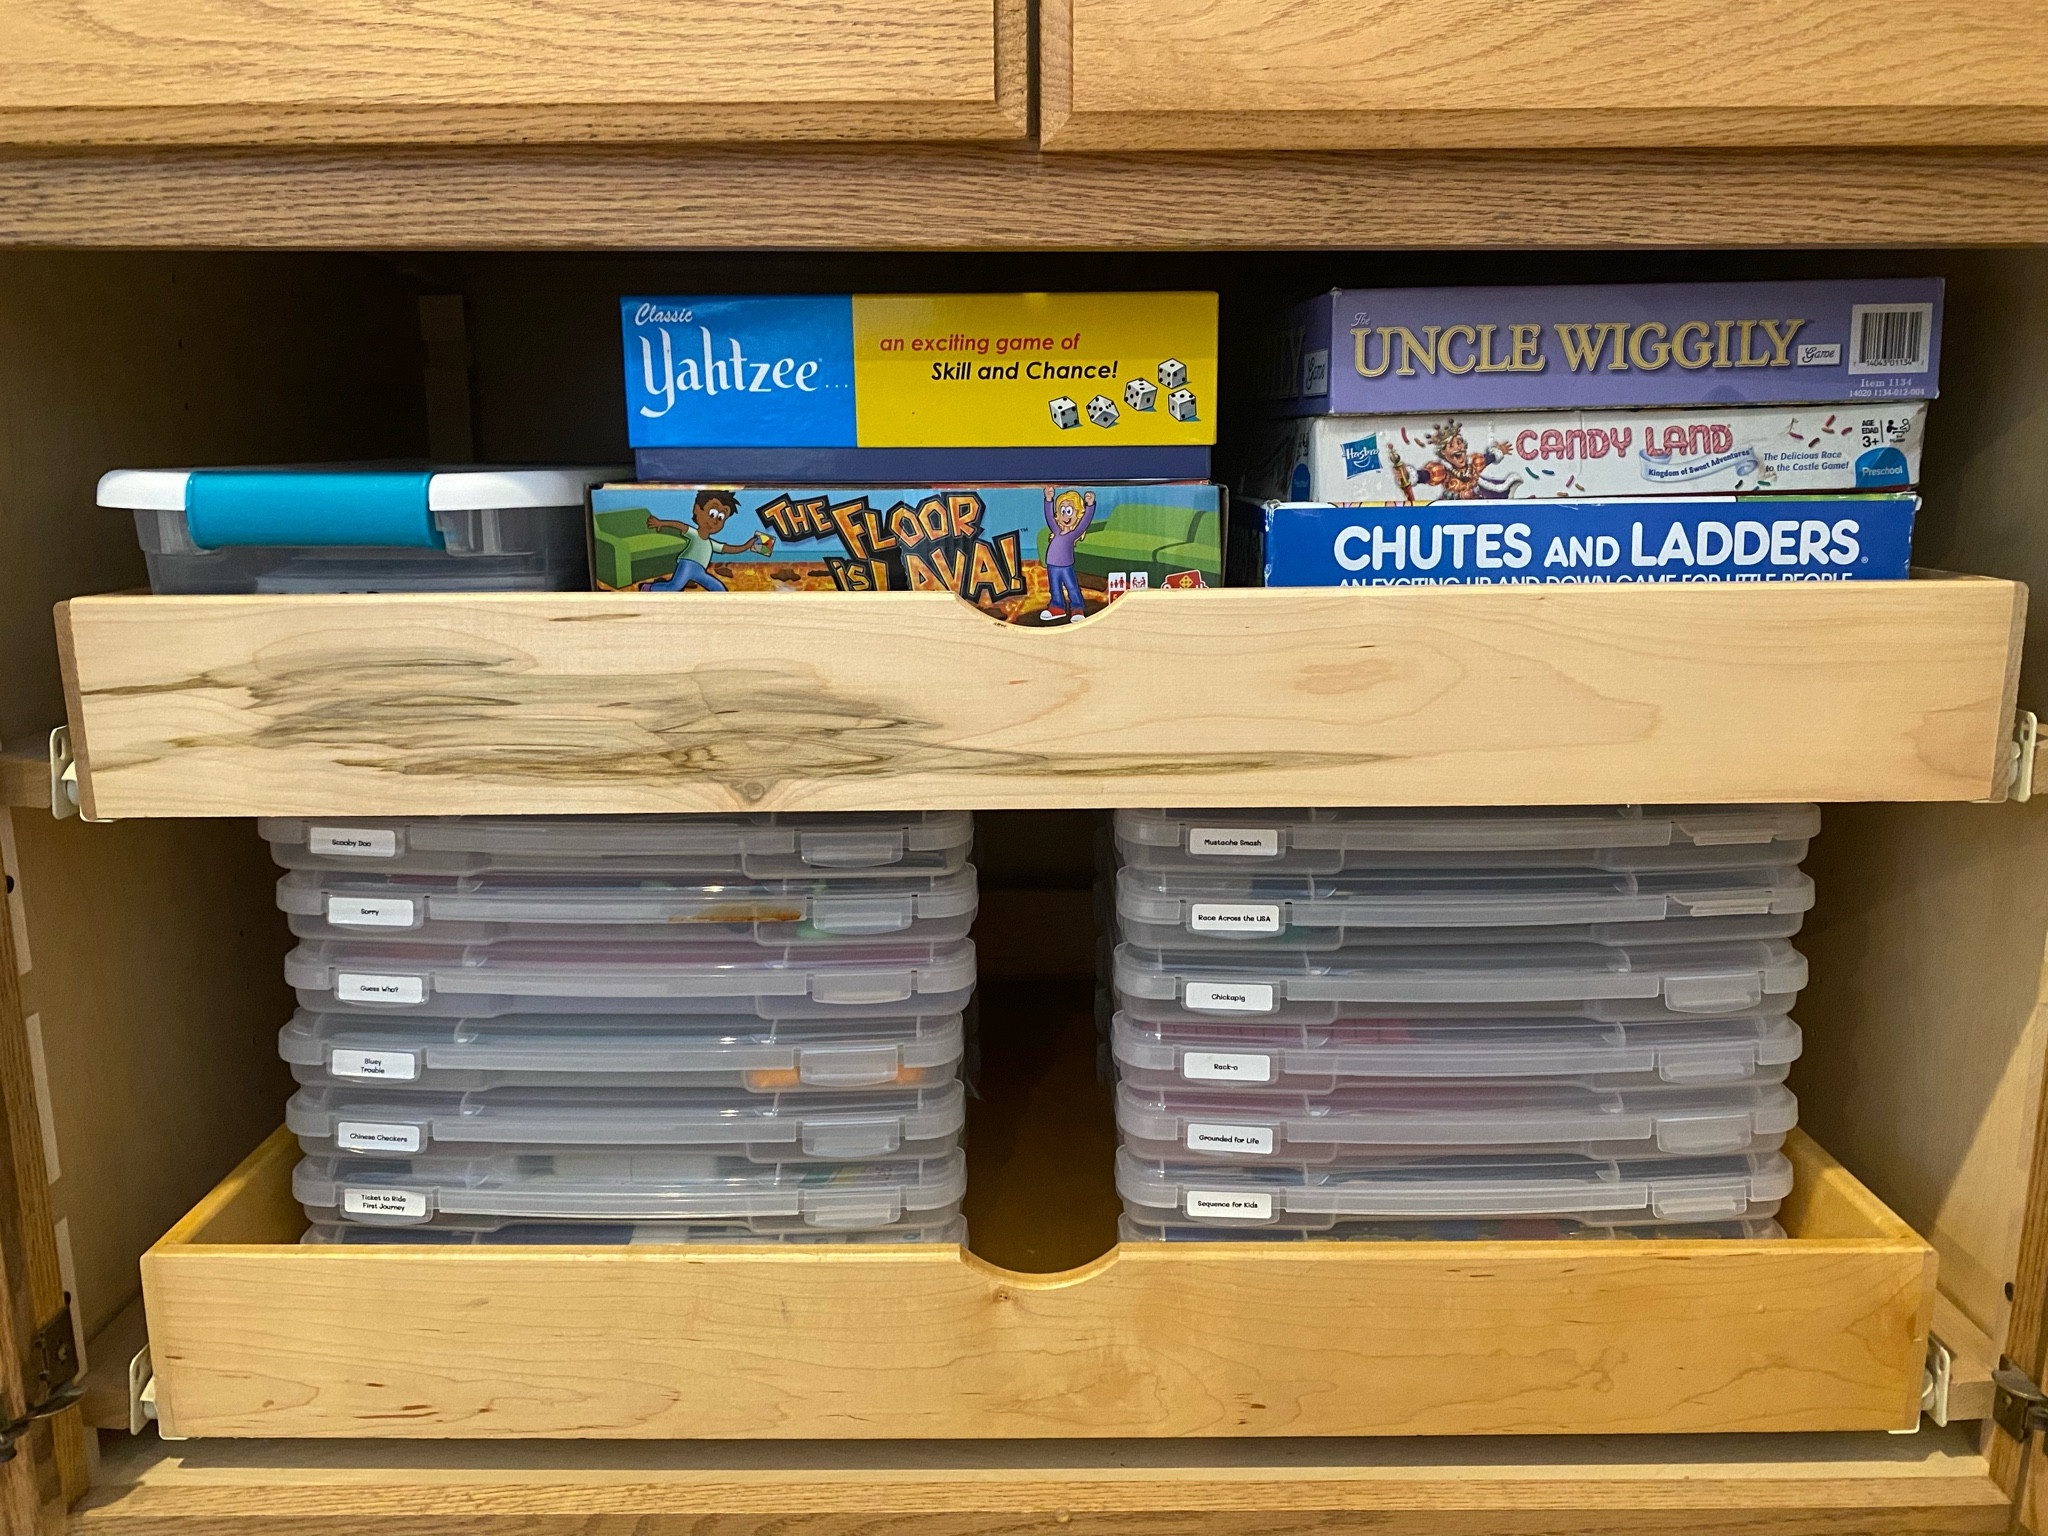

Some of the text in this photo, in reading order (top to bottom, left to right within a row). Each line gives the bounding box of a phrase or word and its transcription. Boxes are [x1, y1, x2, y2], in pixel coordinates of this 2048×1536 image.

[635, 303, 693, 326] Classic
[1351, 312, 1371, 326] The
[880, 333, 1081, 355] an exciting game of
[1350, 324, 1546, 378] UNCLE
[1553, 319, 1804, 371] WIGGILY
[1802, 346, 1835, 364] Game
[931, 361, 1118, 380] Skill and Chance!
[1861, 378, 1912, 388] Item 1134
[1516, 424, 1733, 461] CANDY LAND
[1862, 435, 1879, 447] 3+
[1342, 446, 1379, 460] Hasbro
[1764, 451, 1842, 461] The Delicious Race
[1648, 449, 1750, 478] Kingdom of Sweet Adventures
[1777, 463, 1791, 471] the
[1793, 462, 1819, 471] Castle
[1822, 461, 1849, 470] Game!
[1862, 465, 1903, 477] Preschool
[764, 500, 832, 536] THE
[832, 495, 980, 560] FLOOR
[1334, 519, 1860, 571] CHUTES AND LADDERS
[332, 839, 356, 847] Scooby
[1204, 838, 1238, 846] Mustache
[361, 908, 379, 916] Sorry
[1218, 914, 1241, 922] Across
[1211, 993, 1246, 1002] Chickapig
[364, 1058, 381, 1066] Bluey
[361, 1066, 385, 1074] Trouble
[350, 1132, 408, 1142] Chinese Checkers
[1198, 1134, 1233, 1143] Grounded
[1234, 1136, 1245, 1144] for
[379, 1203, 405, 1212] Journey
[1197, 1200, 1230, 1208] Sequence
